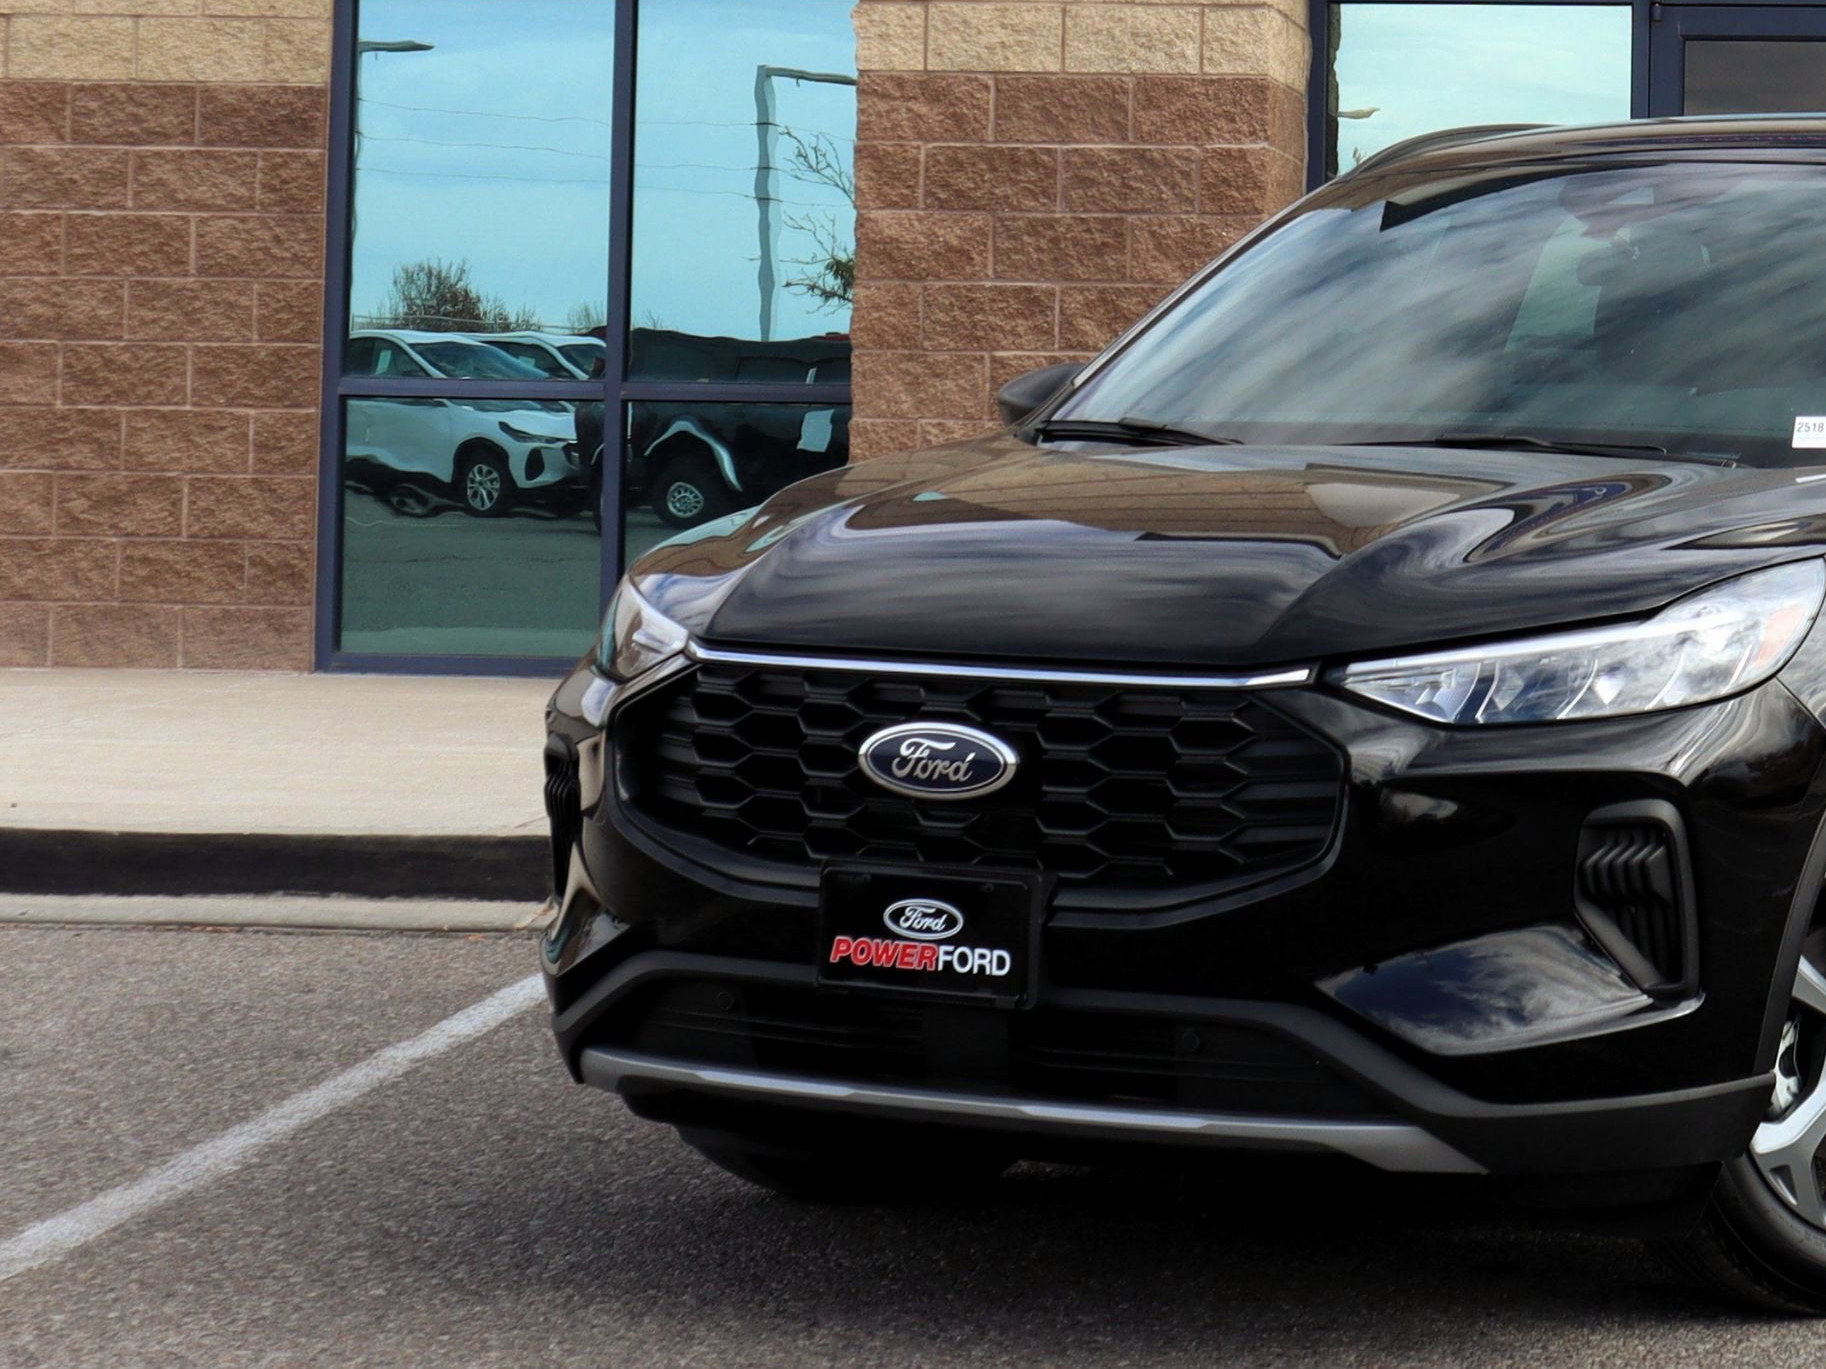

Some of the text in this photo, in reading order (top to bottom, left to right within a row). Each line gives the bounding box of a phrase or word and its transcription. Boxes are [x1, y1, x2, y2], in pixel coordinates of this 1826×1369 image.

[891, 737, 976, 782] Ford
[899, 905, 947, 932] Ford
[830, 936, 1010, 976] POWERFORD
